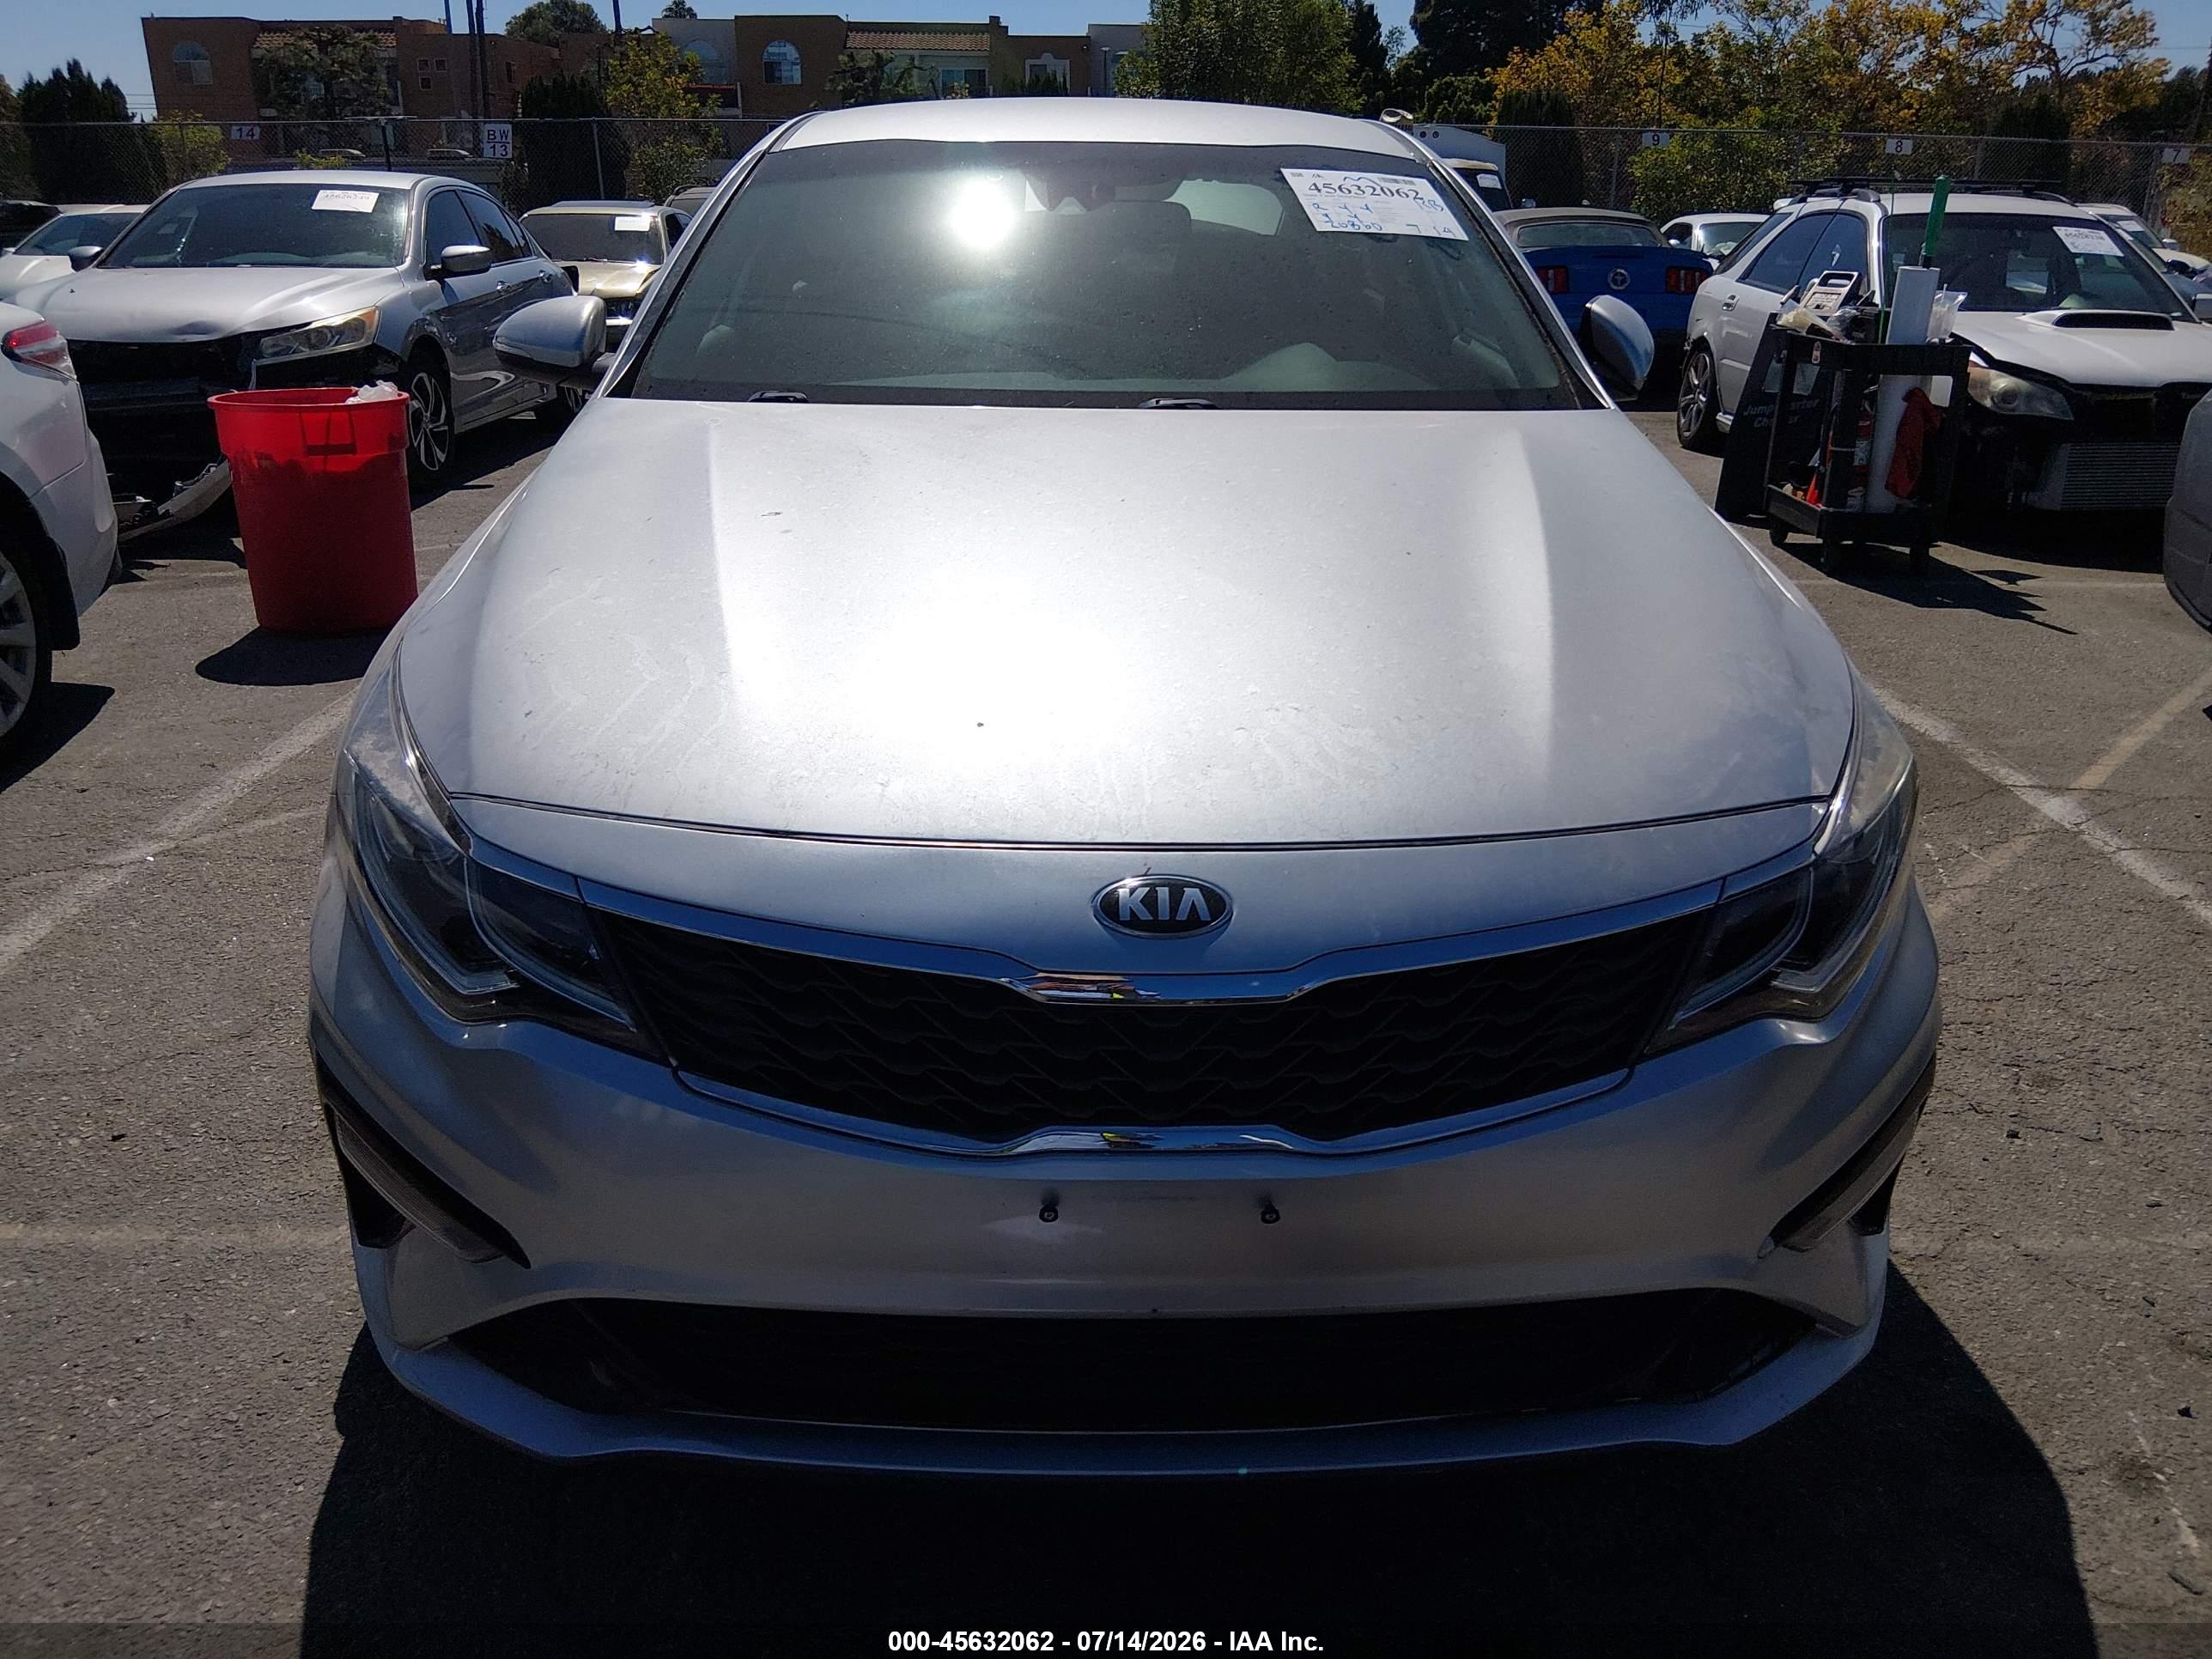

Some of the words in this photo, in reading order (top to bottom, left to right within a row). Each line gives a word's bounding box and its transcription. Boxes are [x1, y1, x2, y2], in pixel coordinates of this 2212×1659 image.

[236, 126, 255, 138] 14
[487, 129, 509, 141] BW
[1652, 133, 1660, 146] 9
[489, 143, 508, 156] 13
[1895, 140, 1903, 153] 8
[2172, 149, 2181, 162] 7
[1308, 181, 1424, 201] 45632062
[1117, 886, 1212, 921] KIA
